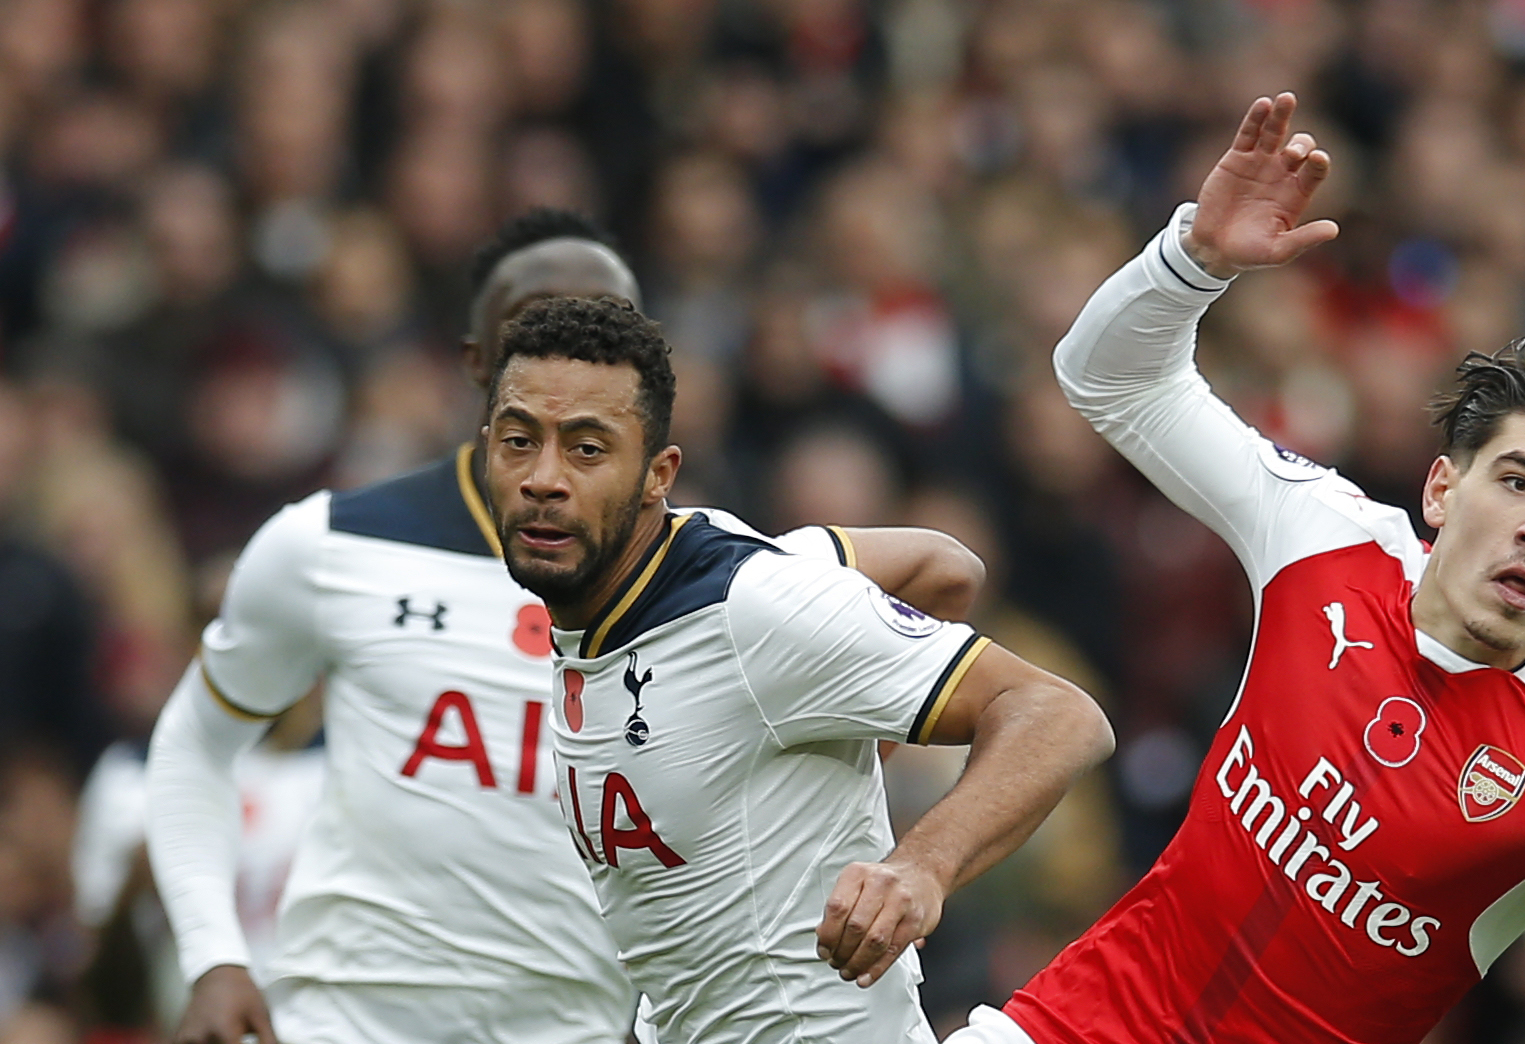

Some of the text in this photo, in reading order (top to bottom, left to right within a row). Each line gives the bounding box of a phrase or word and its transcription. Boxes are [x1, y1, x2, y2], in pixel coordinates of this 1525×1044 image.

[400, 690, 560, 801] AI
[1476, 754, 1521, 787] Arsenal
[567, 765, 688, 869] IA
[1215, 723, 1442, 957] Emirates
[1299, 756, 1380, 851] Fly
